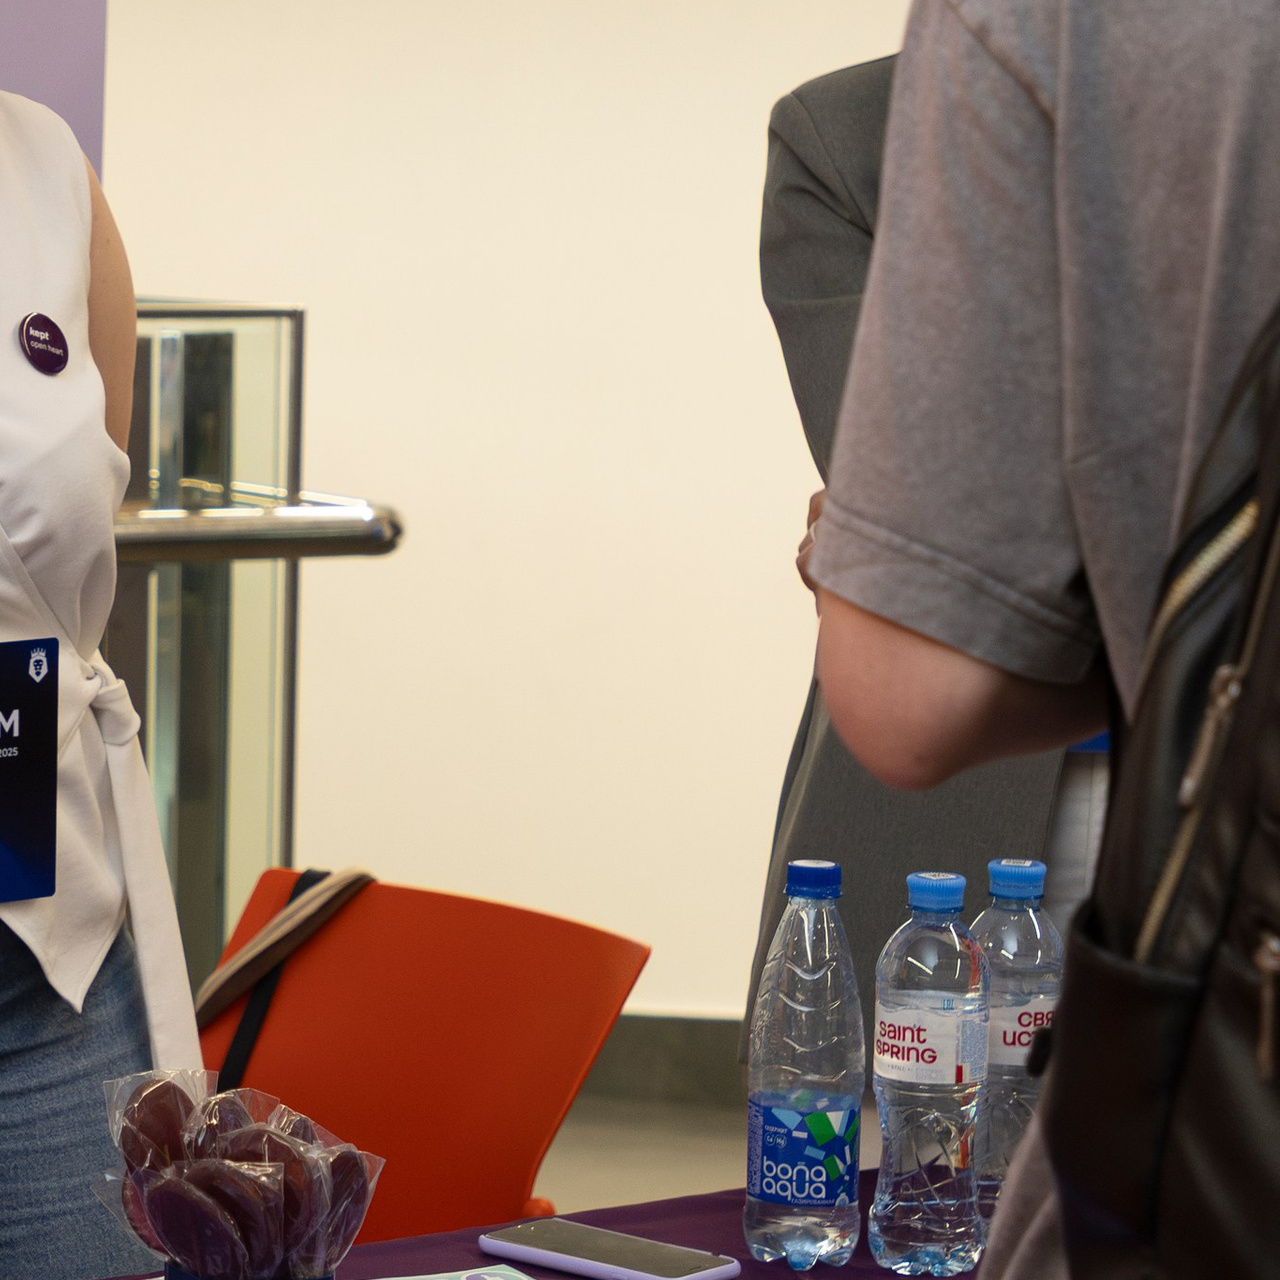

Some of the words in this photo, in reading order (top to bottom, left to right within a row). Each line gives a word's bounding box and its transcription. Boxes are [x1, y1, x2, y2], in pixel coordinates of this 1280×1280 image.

[29, 326, 49, 340] kept
[1002, 1030, 1037, 1047] ИС
[763, 1155, 827, 1182] bona
[762, 1177, 826, 1201] aqua
